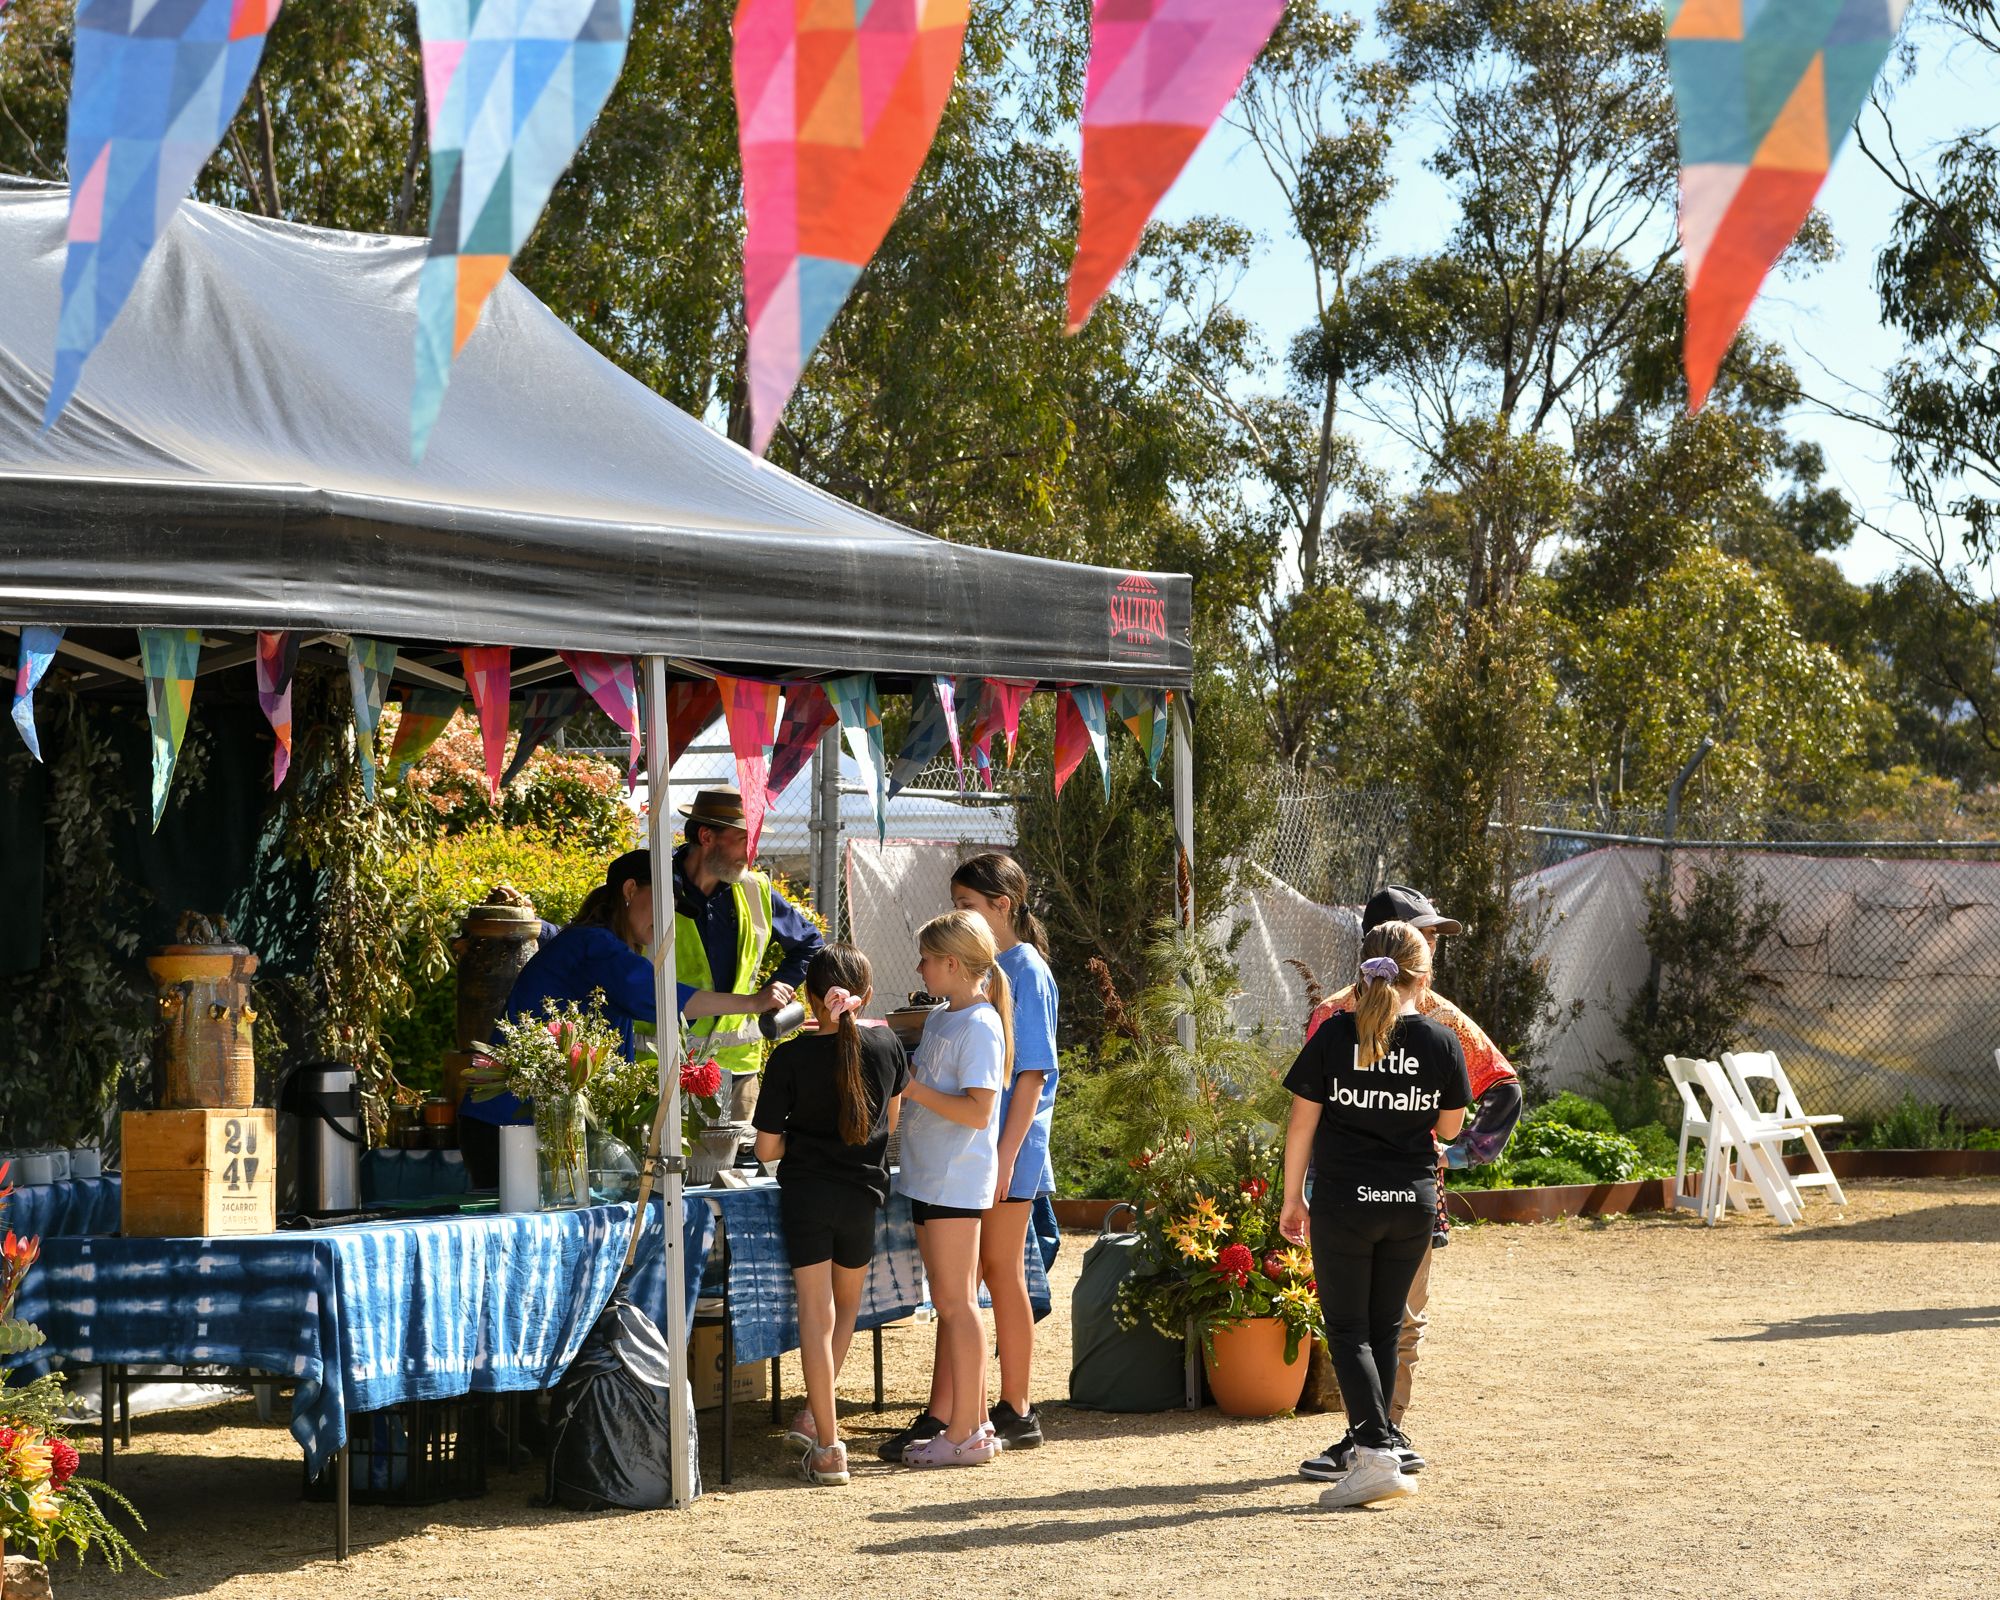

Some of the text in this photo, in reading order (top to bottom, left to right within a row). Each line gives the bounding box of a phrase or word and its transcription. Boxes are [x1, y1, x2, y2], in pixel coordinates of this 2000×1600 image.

[1111, 595, 1165, 641] SALTERS
[1127, 632, 1151, 645] HIRE
[1329, 1077, 1441, 1112] Journalist
[1357, 1186, 1417, 1203] Sieanna
